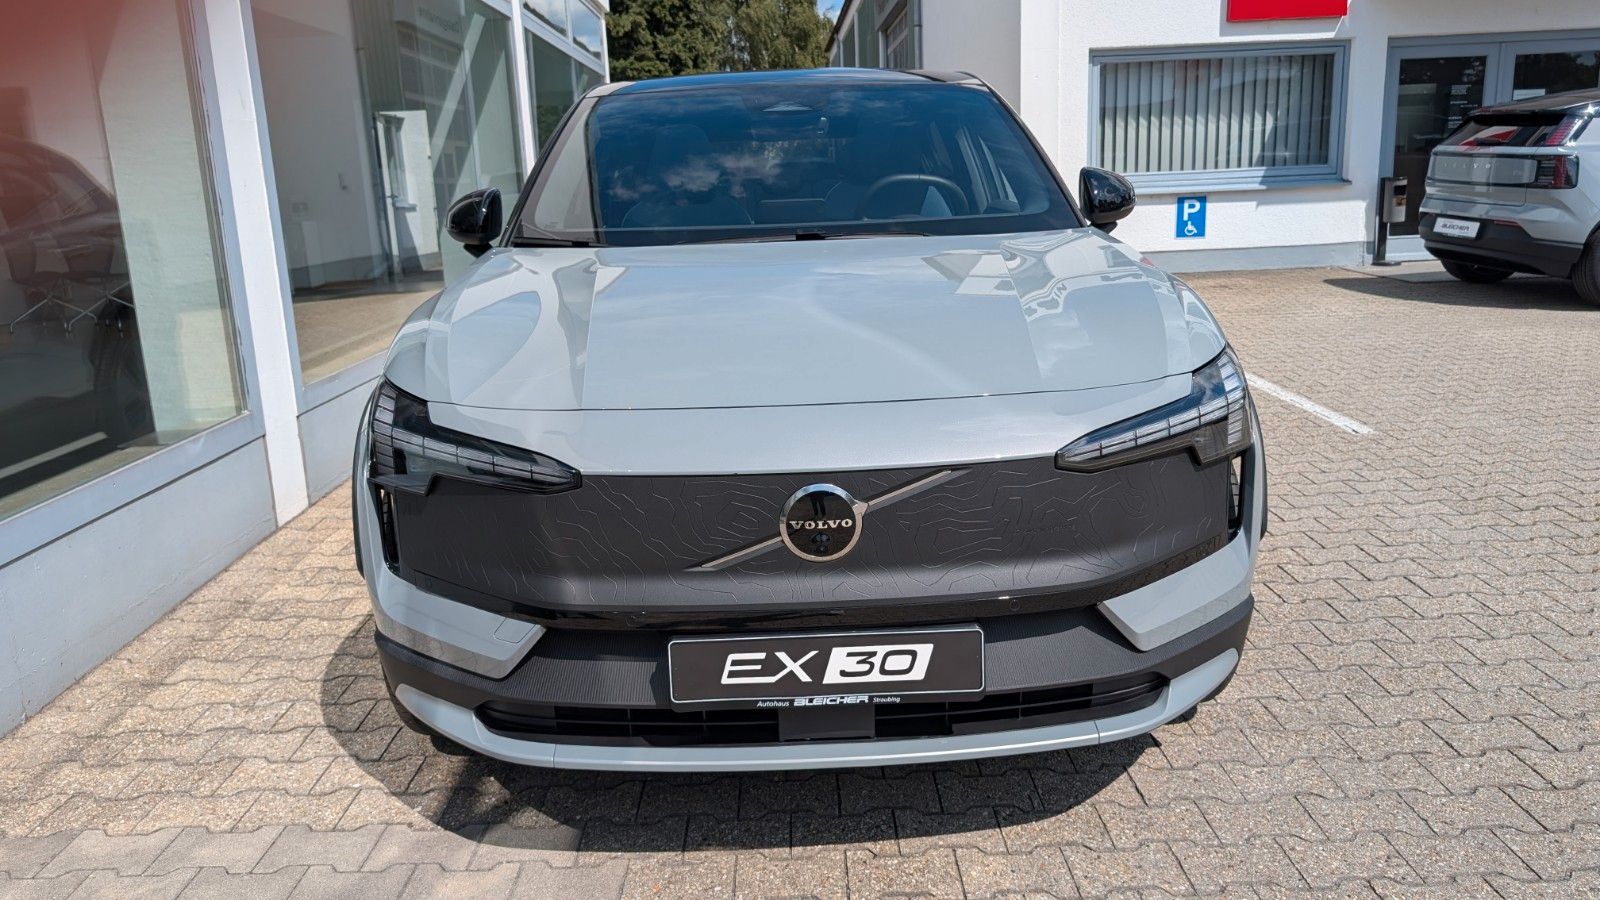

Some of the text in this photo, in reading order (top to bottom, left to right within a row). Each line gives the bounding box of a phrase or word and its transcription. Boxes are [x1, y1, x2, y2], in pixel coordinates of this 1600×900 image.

[1183, 199, 1201, 221] P
[789, 518, 853, 530] VOLVO
[721, 649, 919, 685] EX 30
[756, 695, 901, 708] Autohaus BLEICHER Straubing
